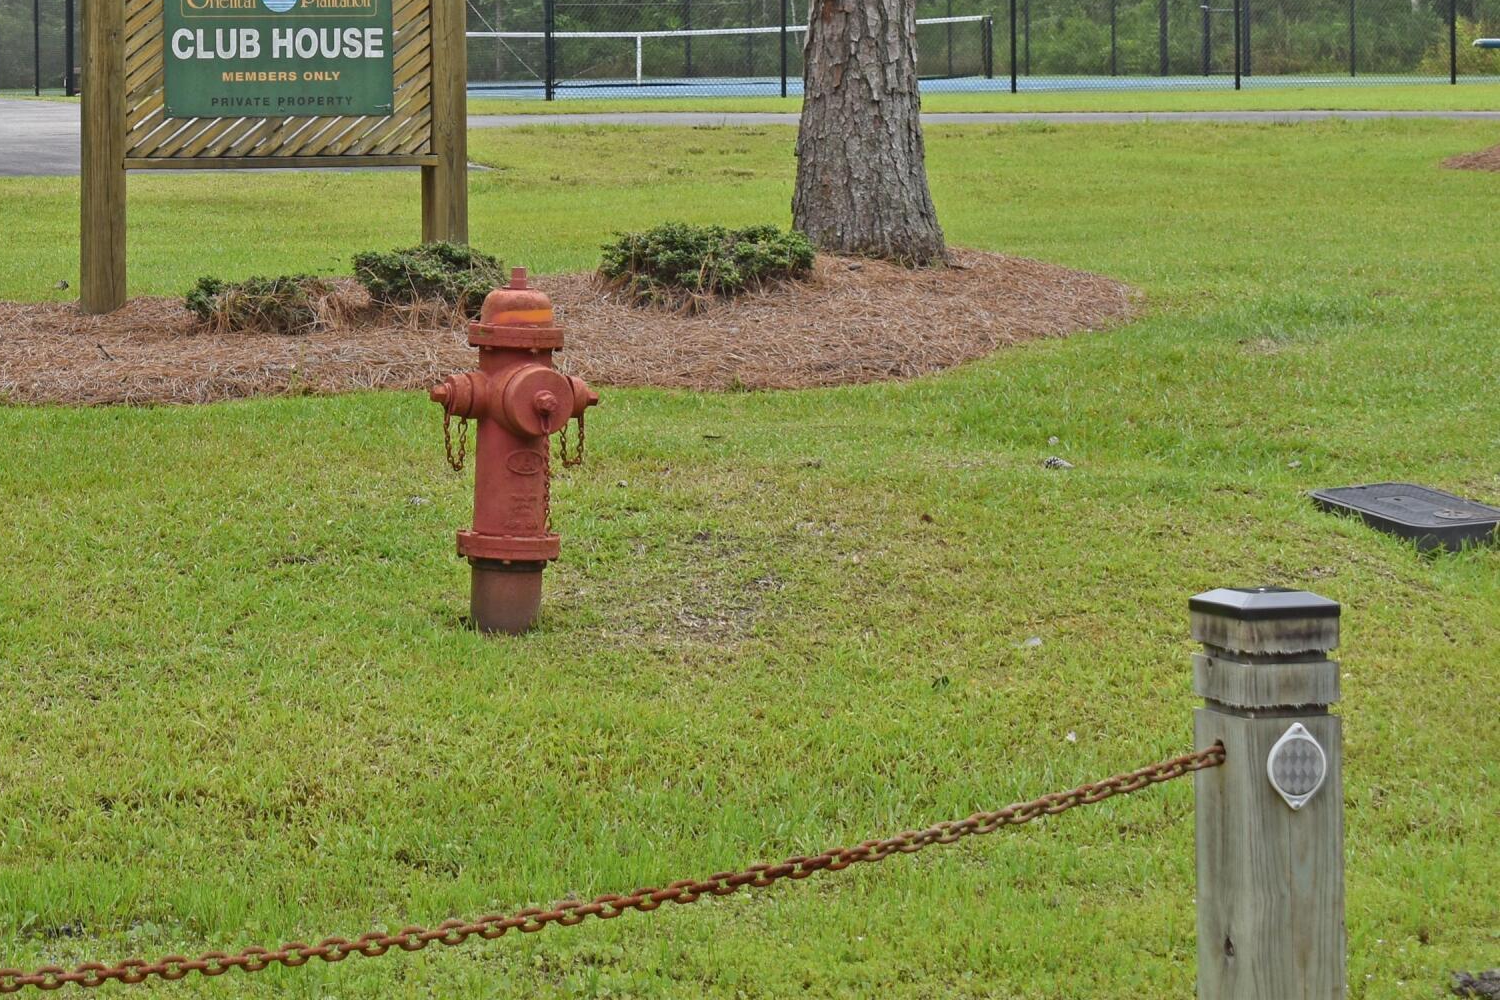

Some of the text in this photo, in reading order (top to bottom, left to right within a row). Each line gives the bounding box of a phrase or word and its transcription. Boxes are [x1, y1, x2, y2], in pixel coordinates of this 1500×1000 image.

[171, 27, 384, 59] CLUB HOUSE
[222, 71, 341, 82] MEMBERS ONLY
[211, 96, 353, 107] PRIVATE PROPERTY
